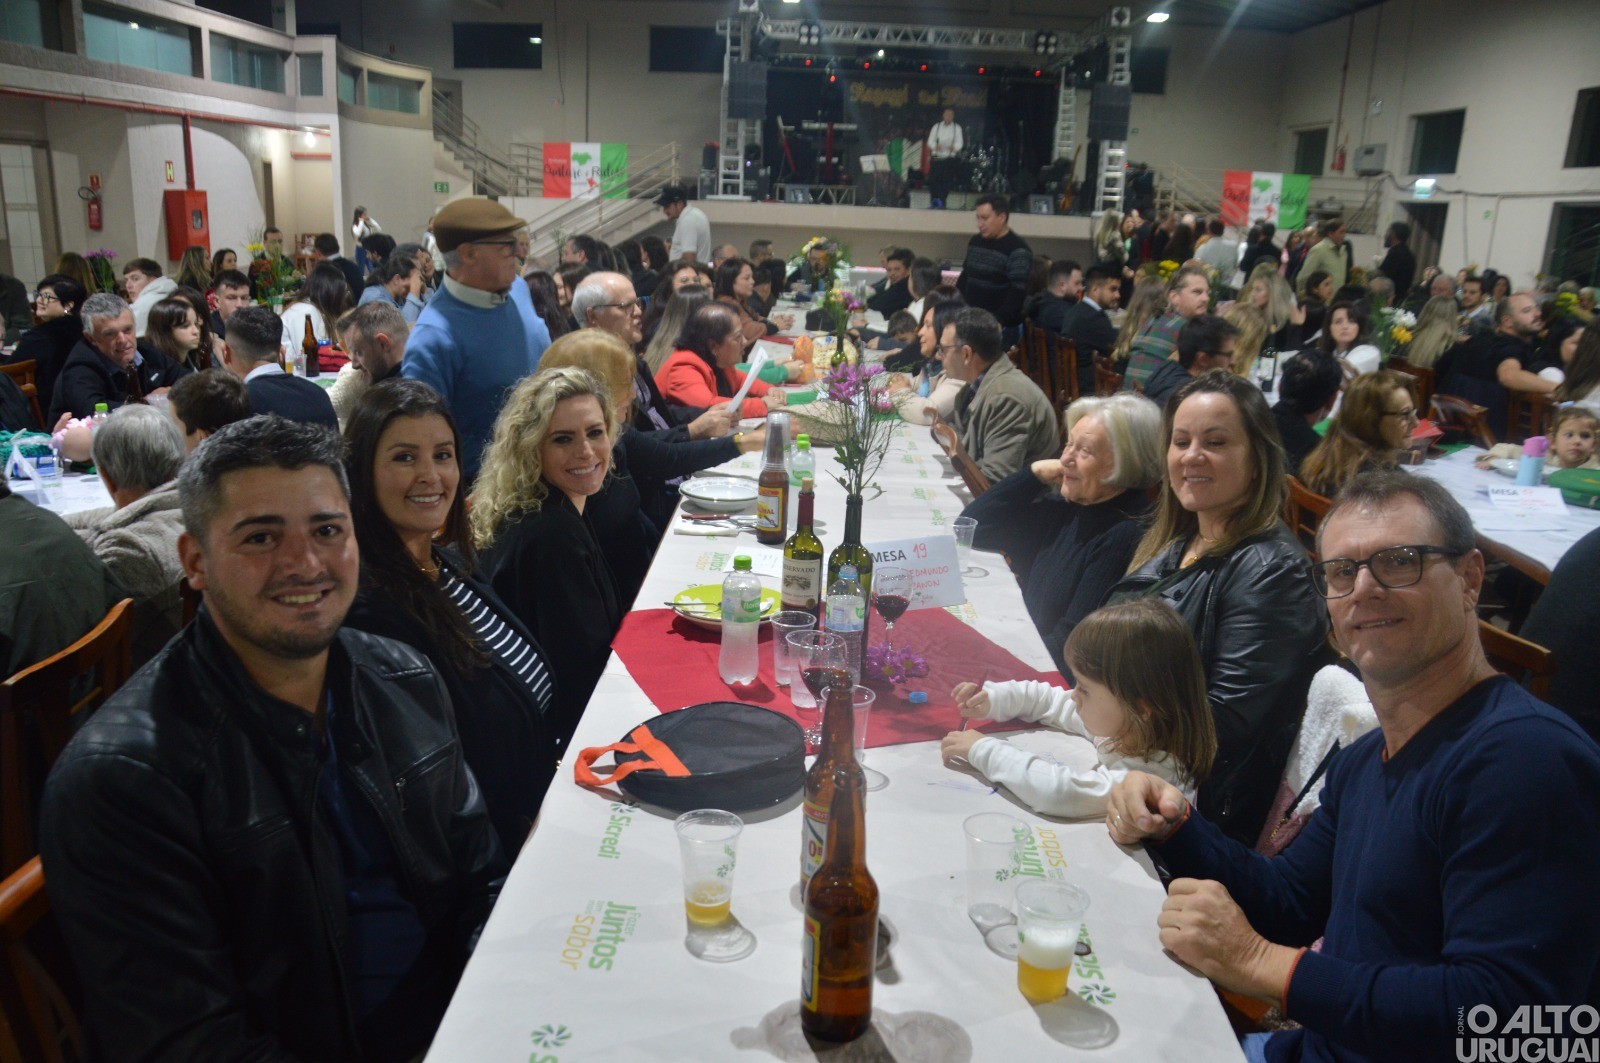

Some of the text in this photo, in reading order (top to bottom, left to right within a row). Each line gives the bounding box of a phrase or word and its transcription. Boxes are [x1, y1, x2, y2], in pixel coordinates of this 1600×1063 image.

[871, 543, 927, 562] MESA 19
[597, 814, 631, 859] Sicredi
[559, 914, 595, 970] sabor
[588, 901, 636, 971] Juntos
